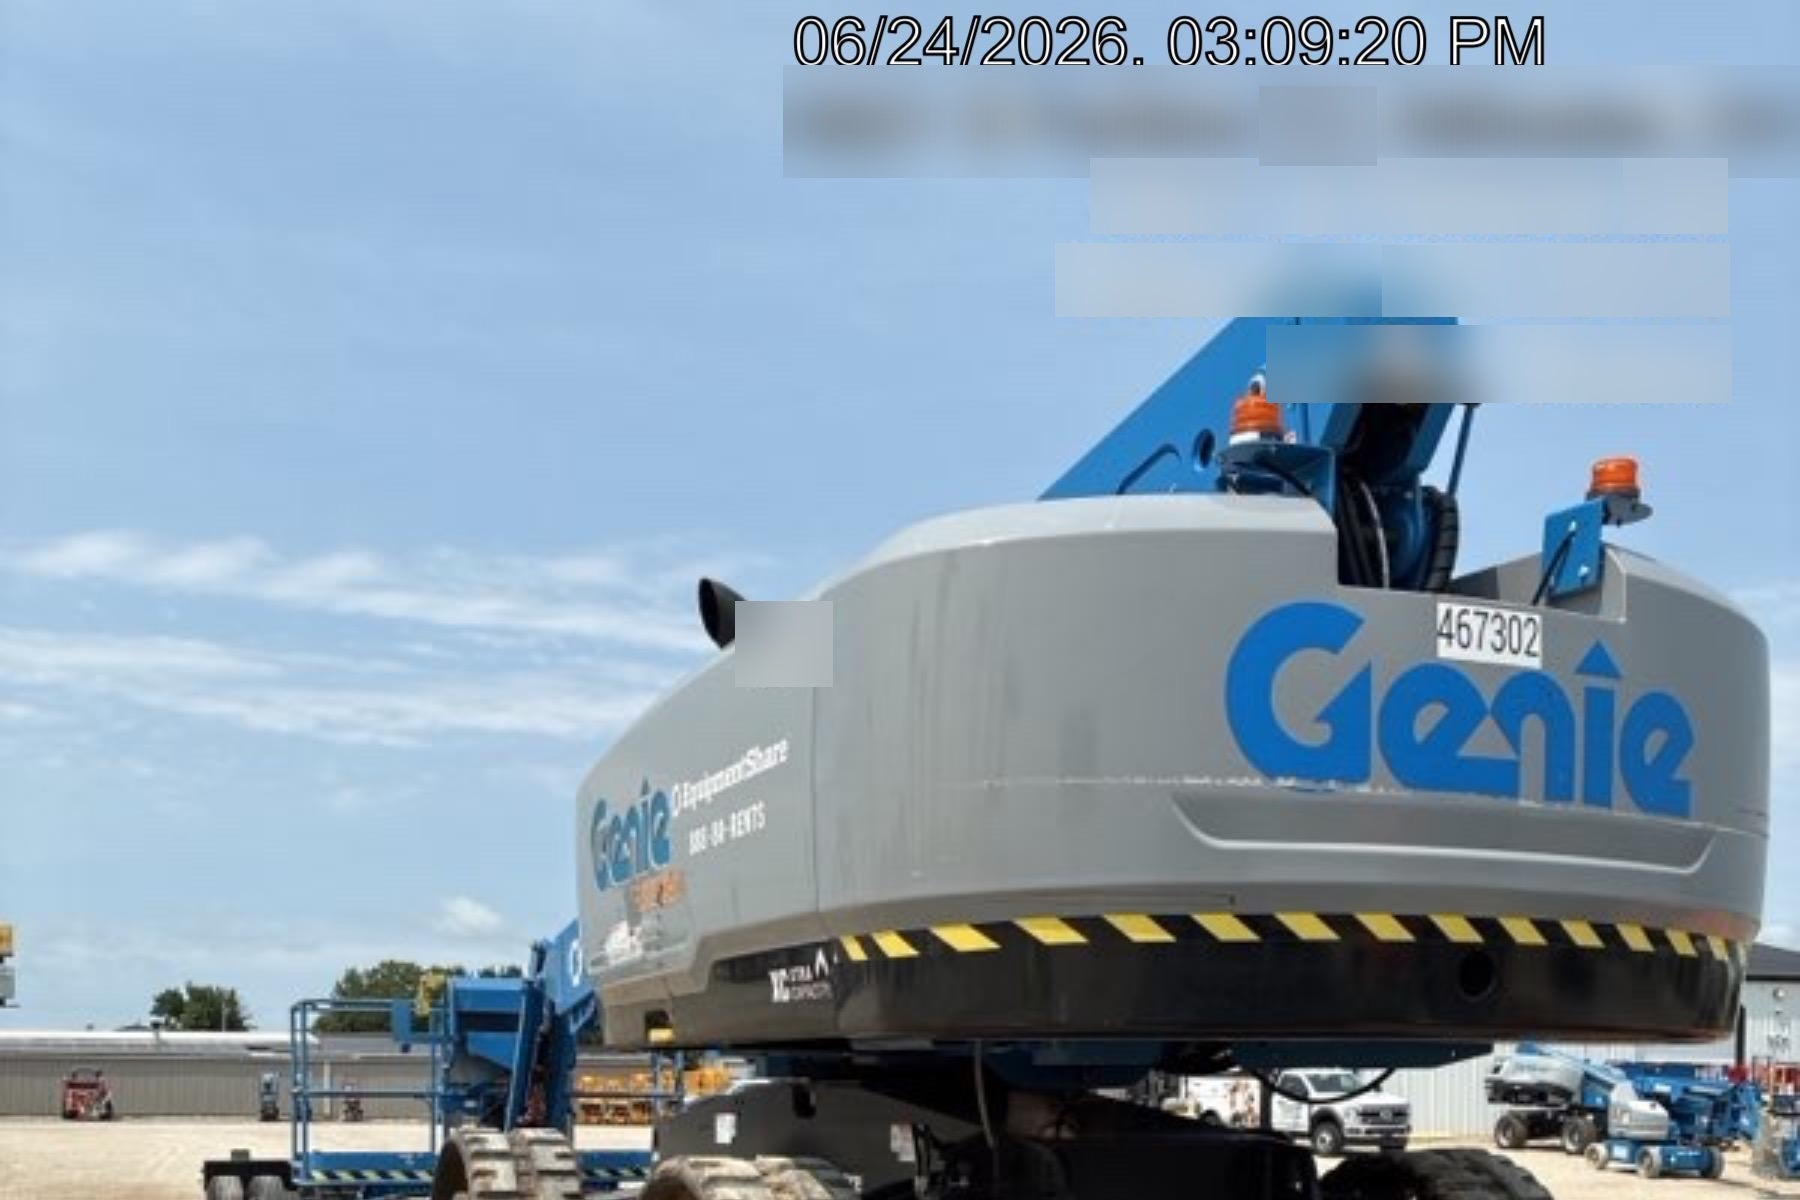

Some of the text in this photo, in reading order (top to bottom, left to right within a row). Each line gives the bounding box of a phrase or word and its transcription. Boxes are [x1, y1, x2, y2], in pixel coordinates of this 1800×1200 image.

[1437, 607, 1540, 659] 467302
[1224, 600, 1695, 819] Genie
[590, 778, 673, 892] Genie
